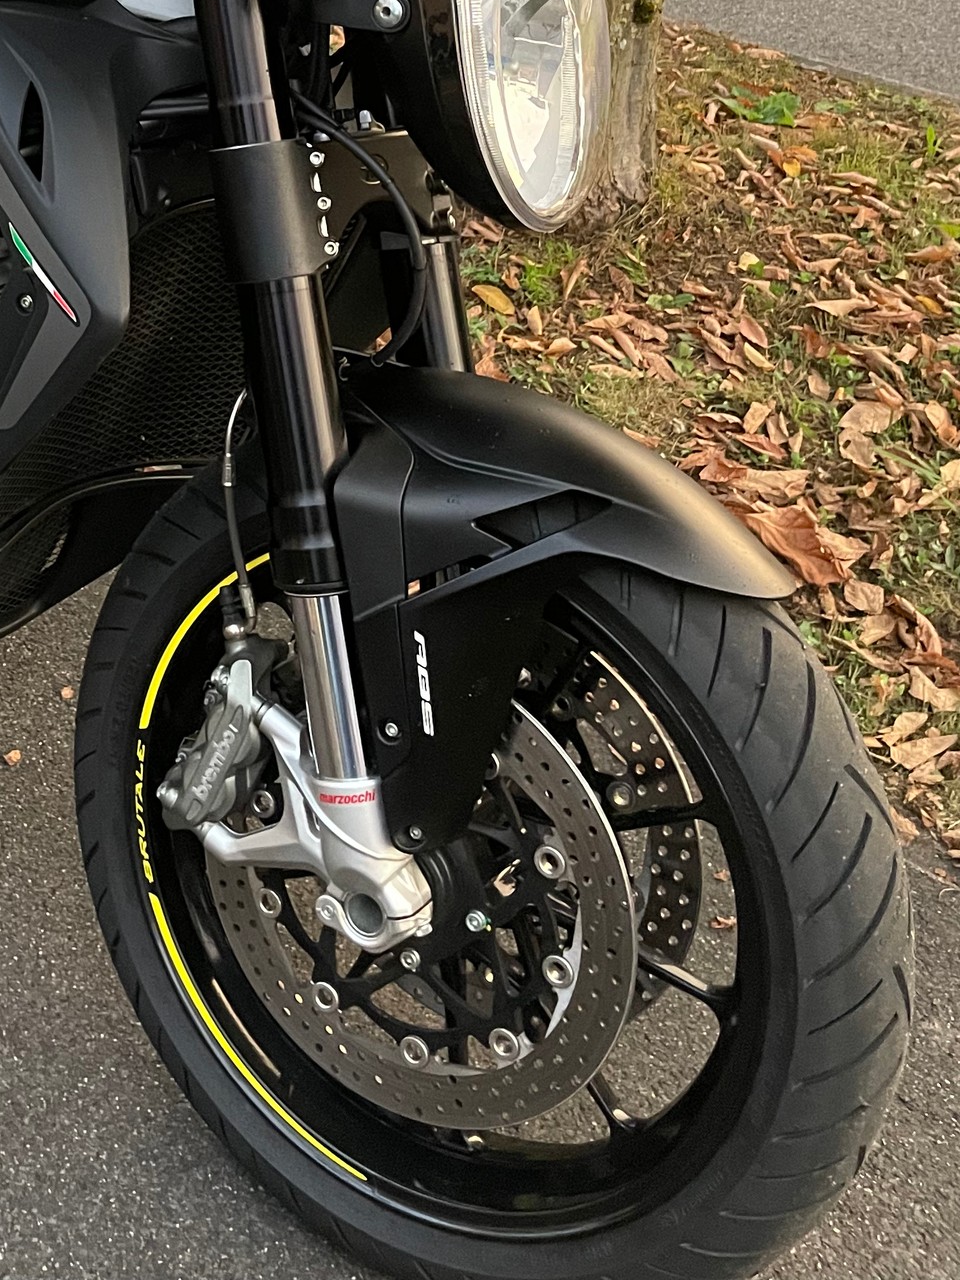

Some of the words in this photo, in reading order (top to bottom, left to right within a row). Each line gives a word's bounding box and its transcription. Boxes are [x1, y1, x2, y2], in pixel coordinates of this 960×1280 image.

[413, 630, 435, 737] ABS
[192, 728, 237, 801] brembo
[319, 789, 377, 805] marzocchi
[135, 739, 154, 883] BRUTALE
